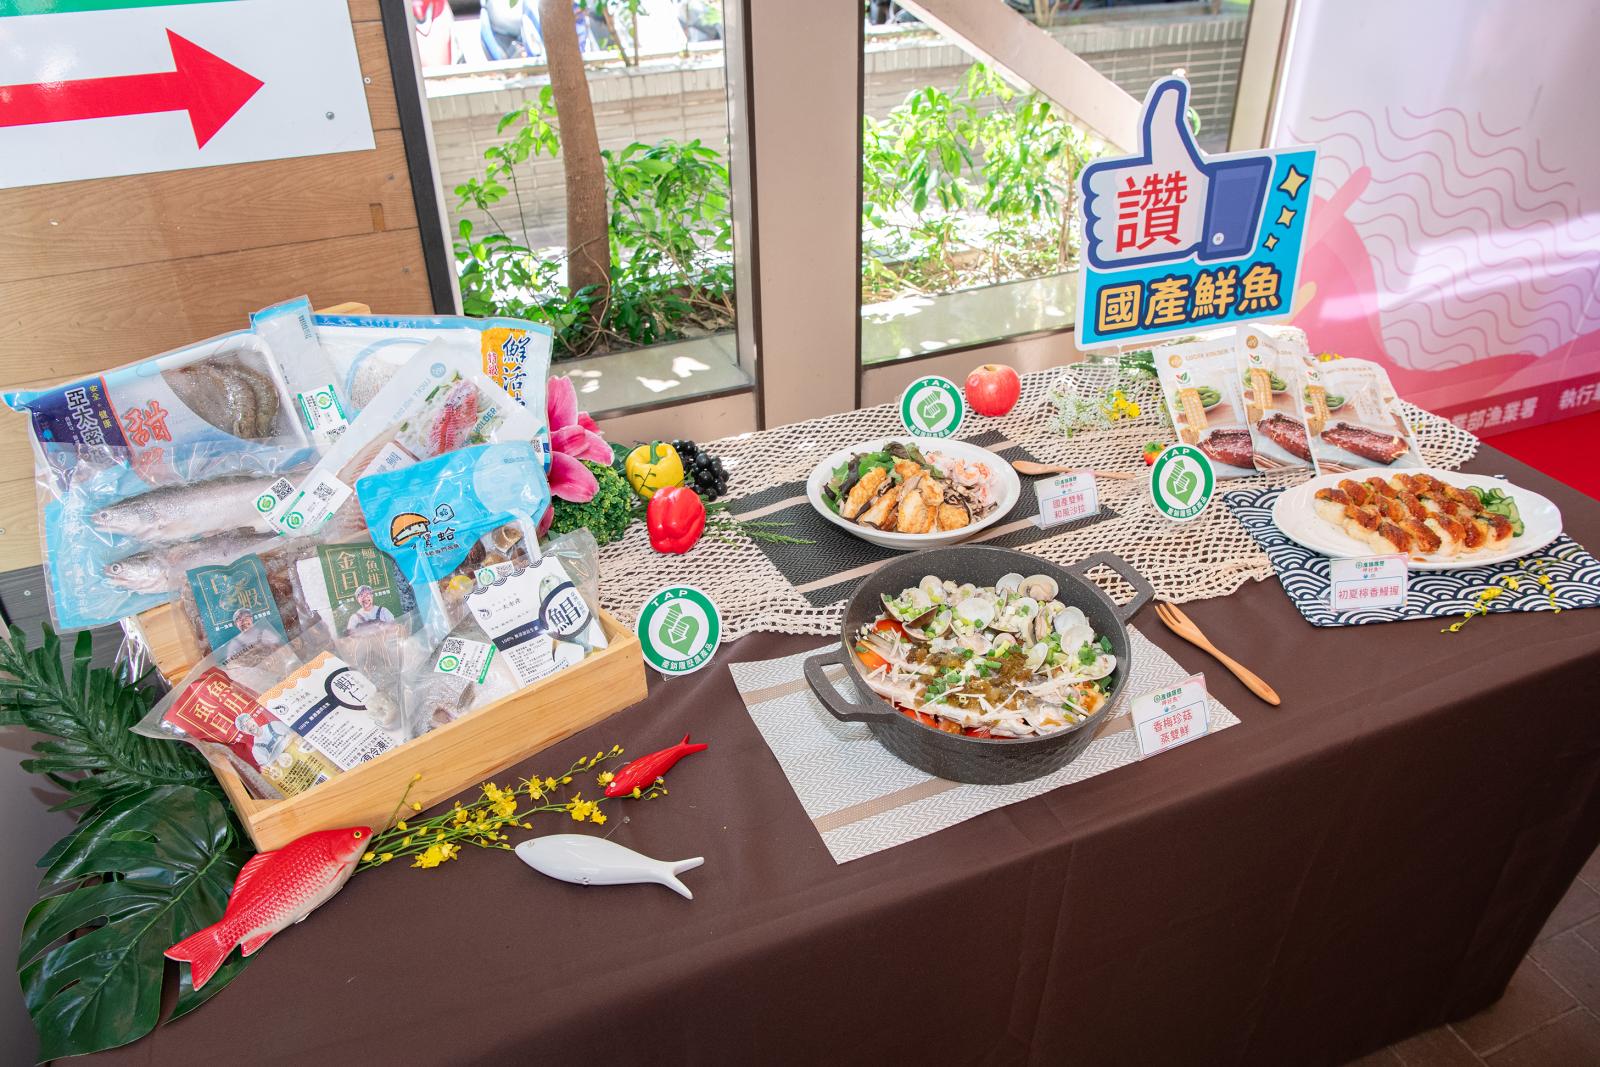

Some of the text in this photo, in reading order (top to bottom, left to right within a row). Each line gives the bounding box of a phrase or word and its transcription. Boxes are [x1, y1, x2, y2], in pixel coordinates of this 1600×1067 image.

[1115, 170, 1188, 253] 讚
[1097, 264, 1280, 332] 國產鮮魚
[921, 379, 951, 389] TAP
[1162, 448, 1190, 461] TAP
[650, 589, 688, 607] TAP
